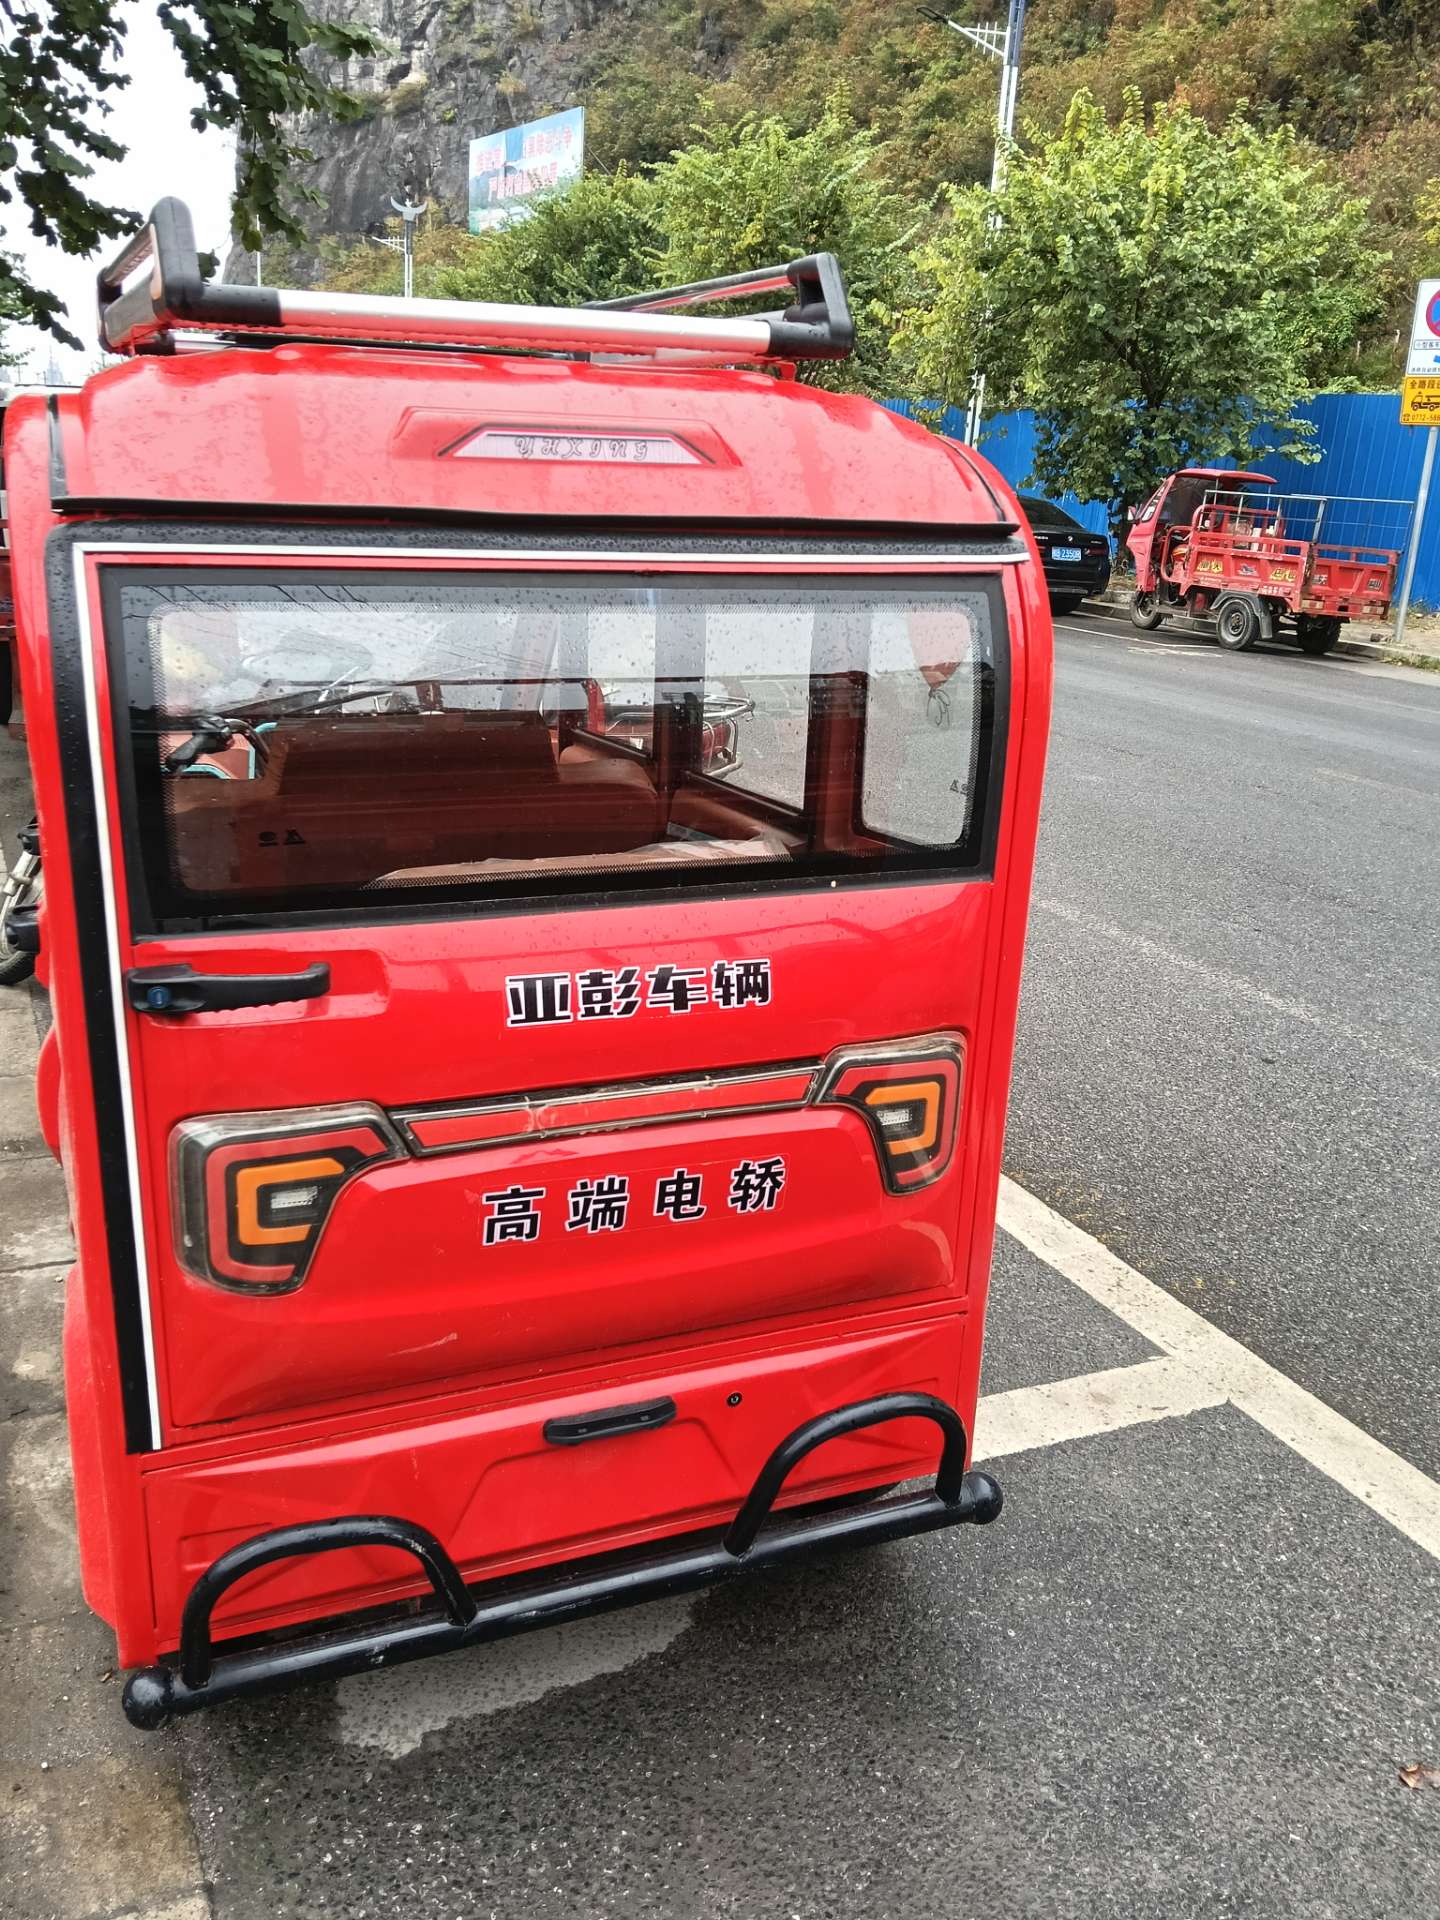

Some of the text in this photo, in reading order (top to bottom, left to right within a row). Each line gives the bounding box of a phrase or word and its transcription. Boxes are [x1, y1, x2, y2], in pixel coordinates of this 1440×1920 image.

[506, 959, 771, 1027] 亚彭车辆
[483, 1157, 785, 1245] 高端电轿
